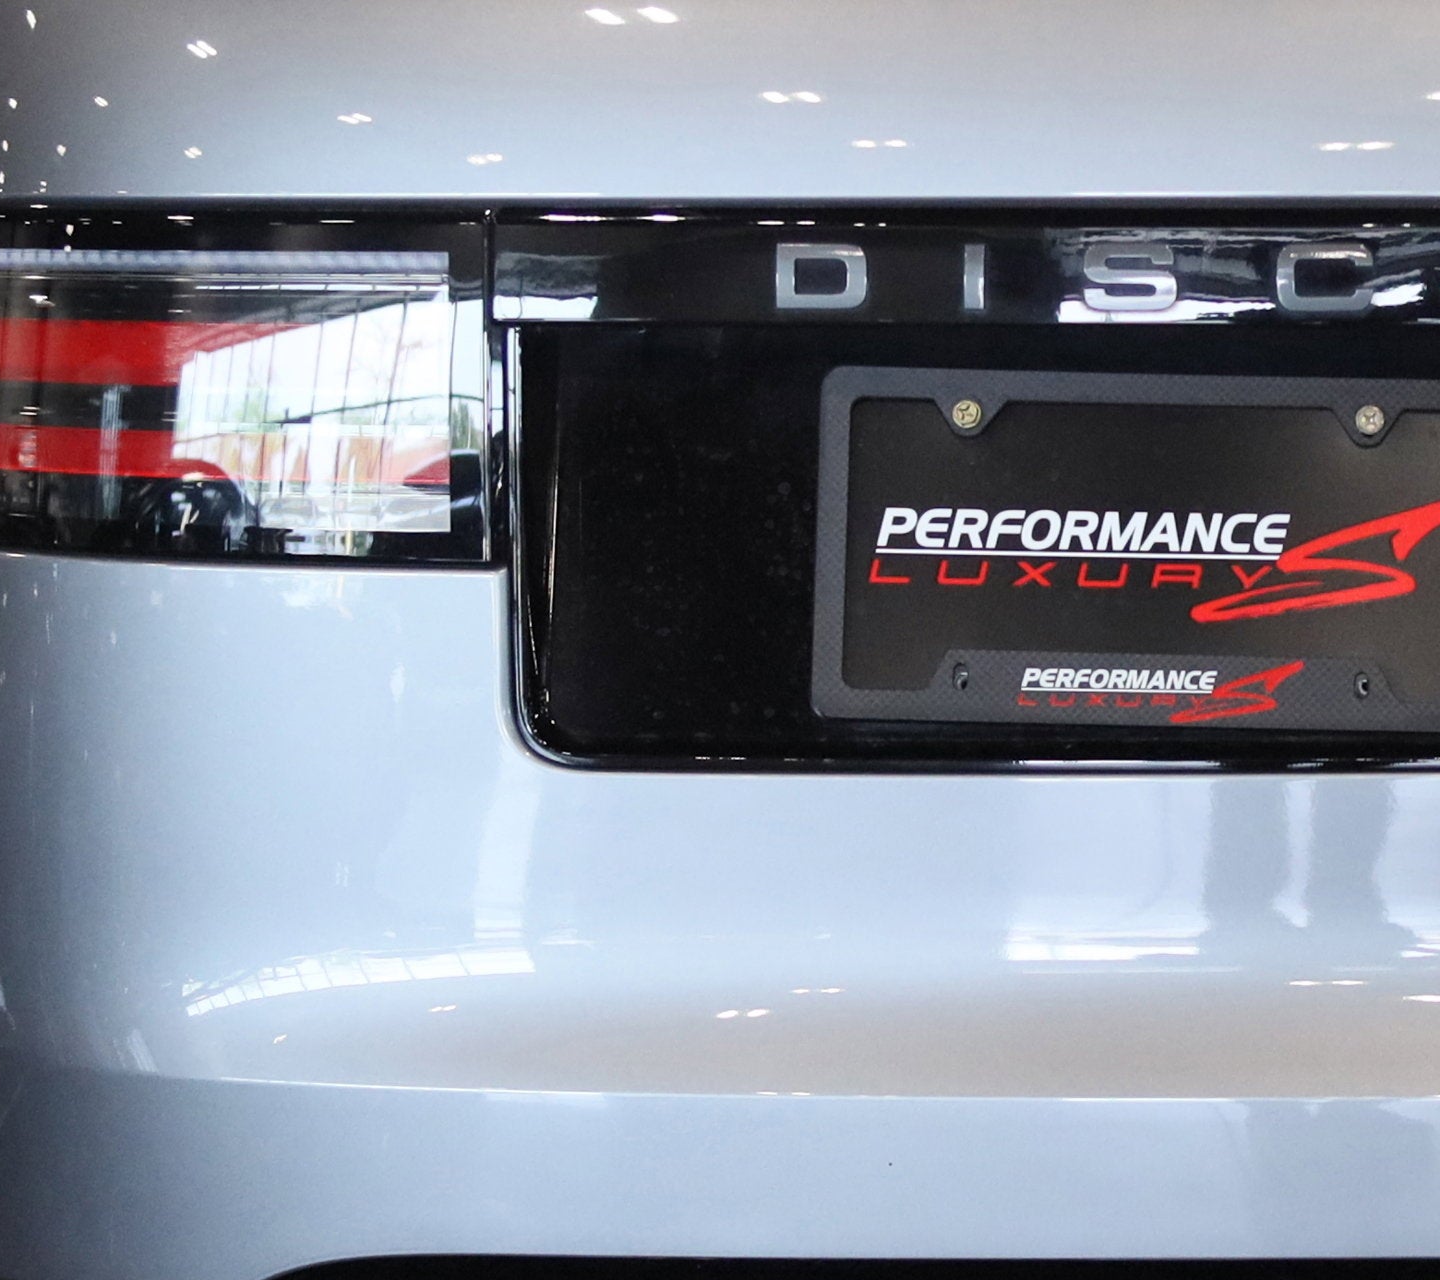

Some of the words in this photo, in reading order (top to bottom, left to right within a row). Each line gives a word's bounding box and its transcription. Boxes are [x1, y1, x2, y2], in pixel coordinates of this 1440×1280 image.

[876, 506, 1291, 554] PERFORMANCE
[868, 559, 1272, 589] LUXURY
[1020, 667, 1218, 691] PERFORMANCE
[1017, 691, 1209, 712] LUXURY
